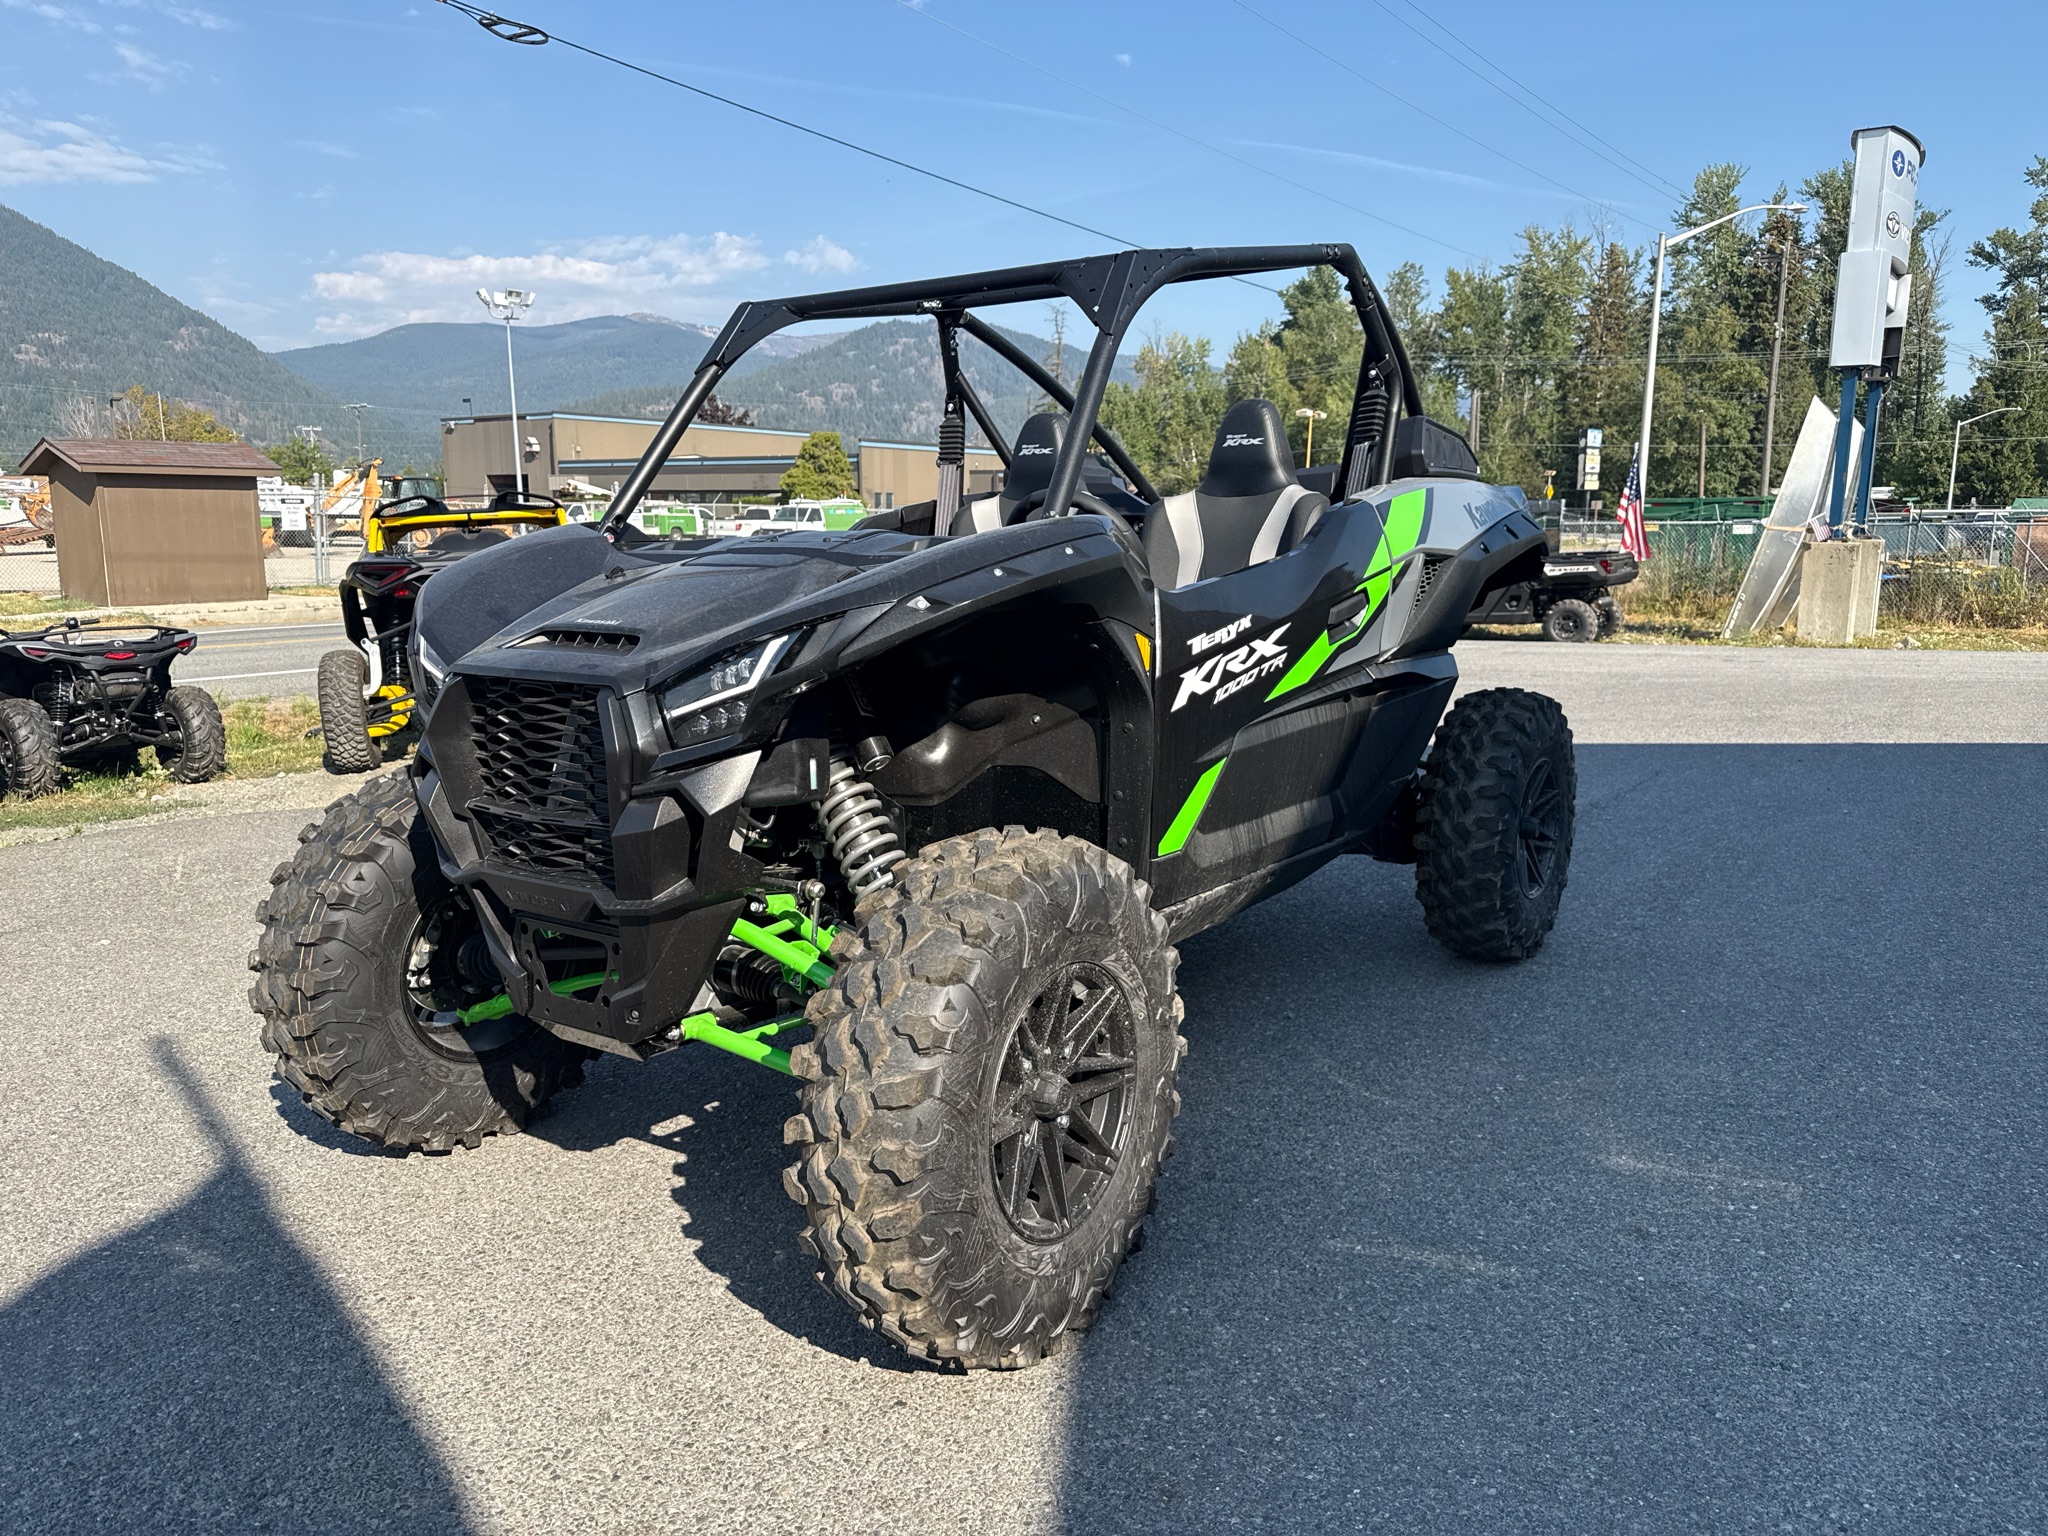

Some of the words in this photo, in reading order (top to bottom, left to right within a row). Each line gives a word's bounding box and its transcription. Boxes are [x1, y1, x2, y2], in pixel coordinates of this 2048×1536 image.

[1222, 437, 1265, 447] KRX
[1018, 447, 1054, 456] KRX
[574, 617, 622, 626] Kawasaki
[1170, 622, 1292, 713] KRX
[1213, 666, 1260, 705] 1000
[1260, 652, 1288, 677] TR
